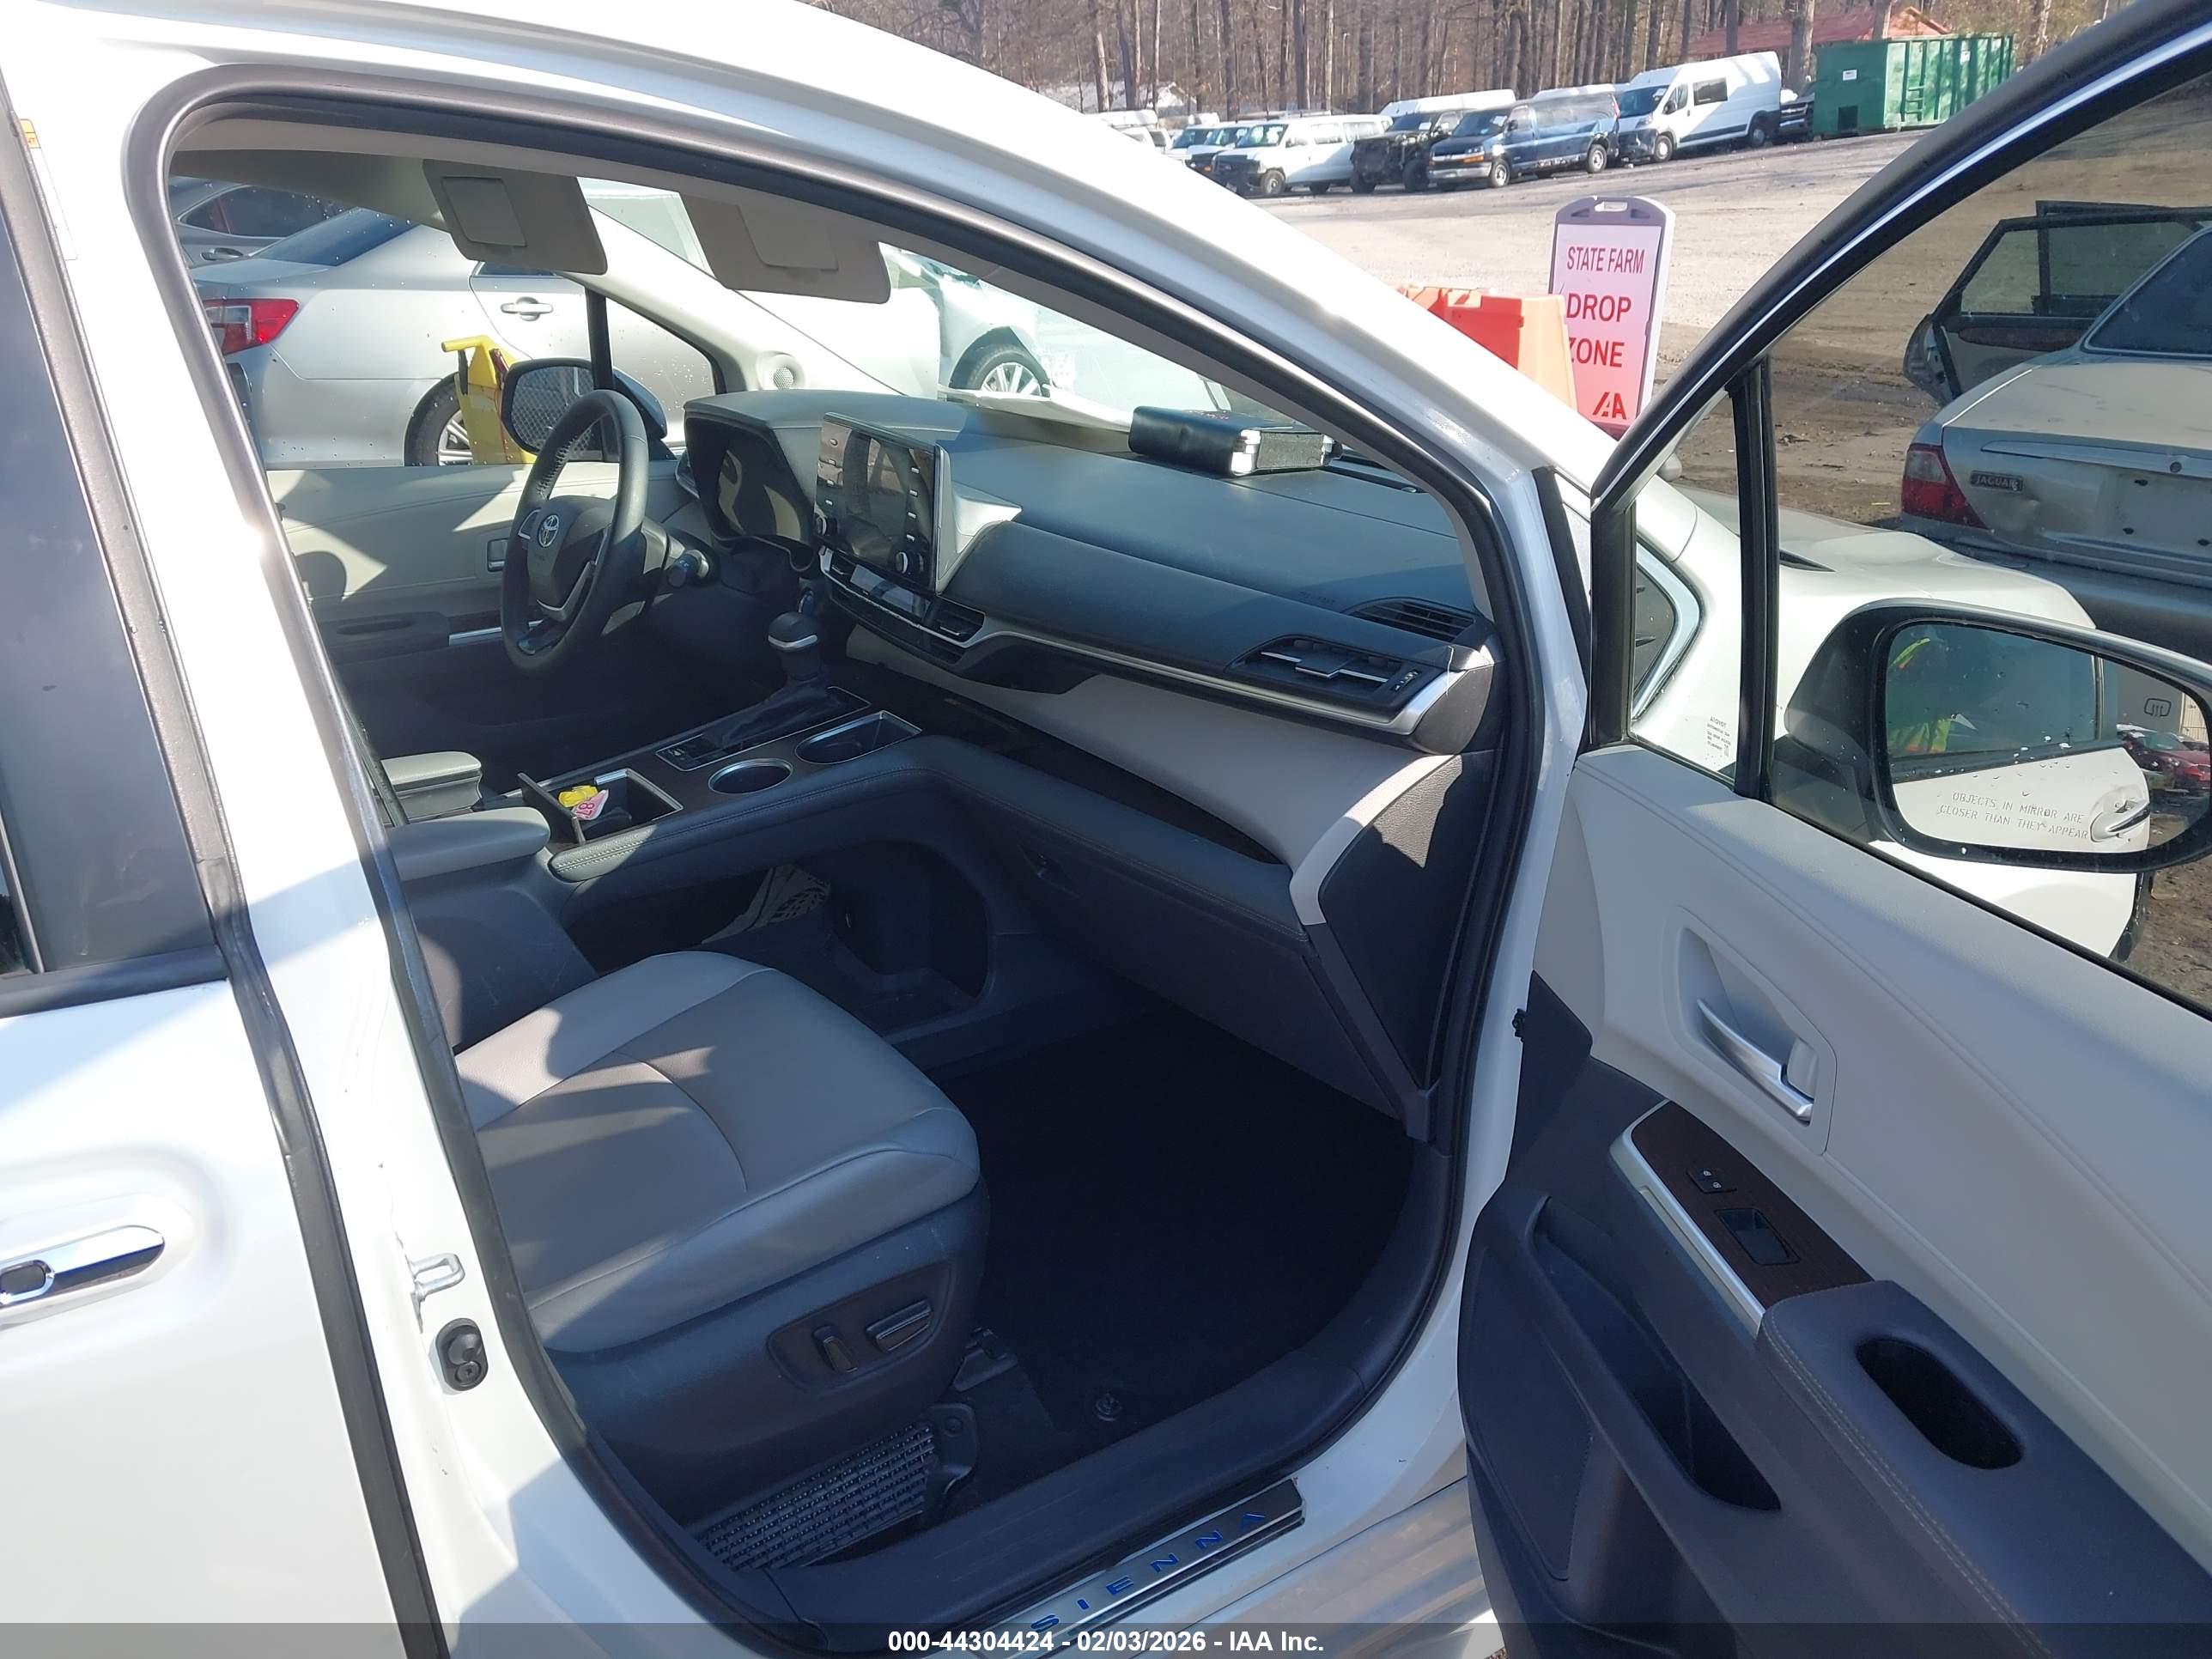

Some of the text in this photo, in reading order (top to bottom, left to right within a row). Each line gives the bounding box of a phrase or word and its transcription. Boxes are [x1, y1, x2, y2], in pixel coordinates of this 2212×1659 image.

[1566, 246, 1645, 274] STATE FARM
[1565, 293, 1632, 322] DROP
[1976, 474, 2020, 491] JAGUAR
[1938, 804, 2089, 839] CLOSER THAN THEY APPEAR
[1952, 792, 2085, 824] OBJECTS IN MIRROR ARE
[1030, 1511, 1267, 1632] SIENNA
